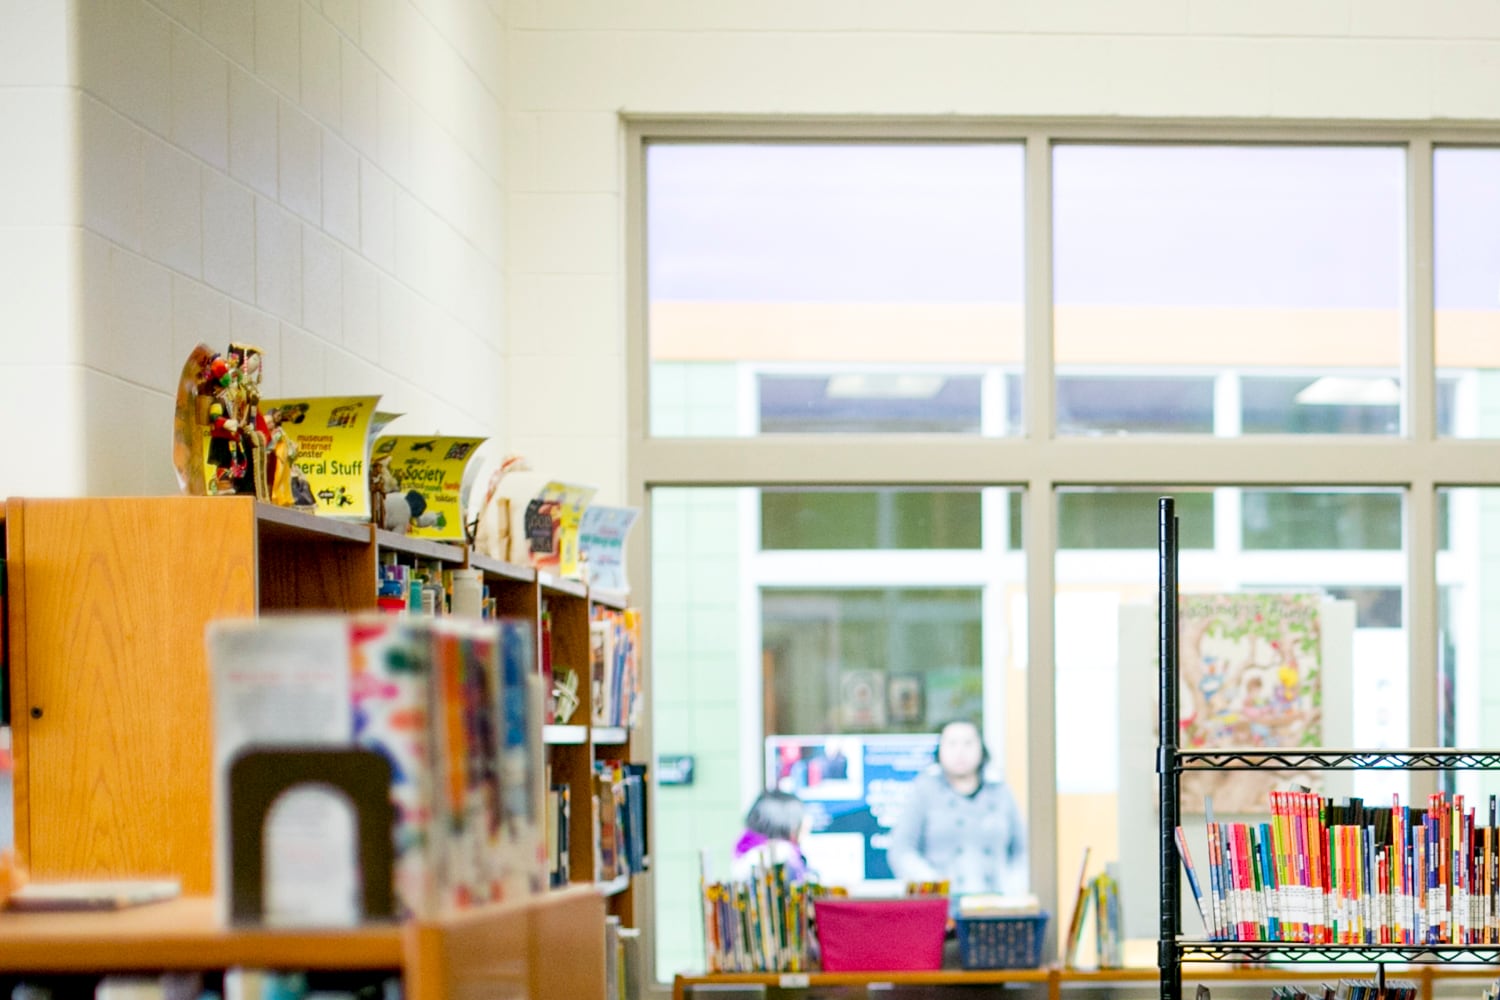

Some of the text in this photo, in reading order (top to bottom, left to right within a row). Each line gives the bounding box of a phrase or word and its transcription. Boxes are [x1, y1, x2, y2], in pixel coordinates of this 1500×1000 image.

[297, 434, 333, 443] museums
[301, 442, 331, 451] Internet
[296, 450, 324, 459] onster
[330, 460, 363, 476] Stuff
[404, 464, 447, 484] Society
